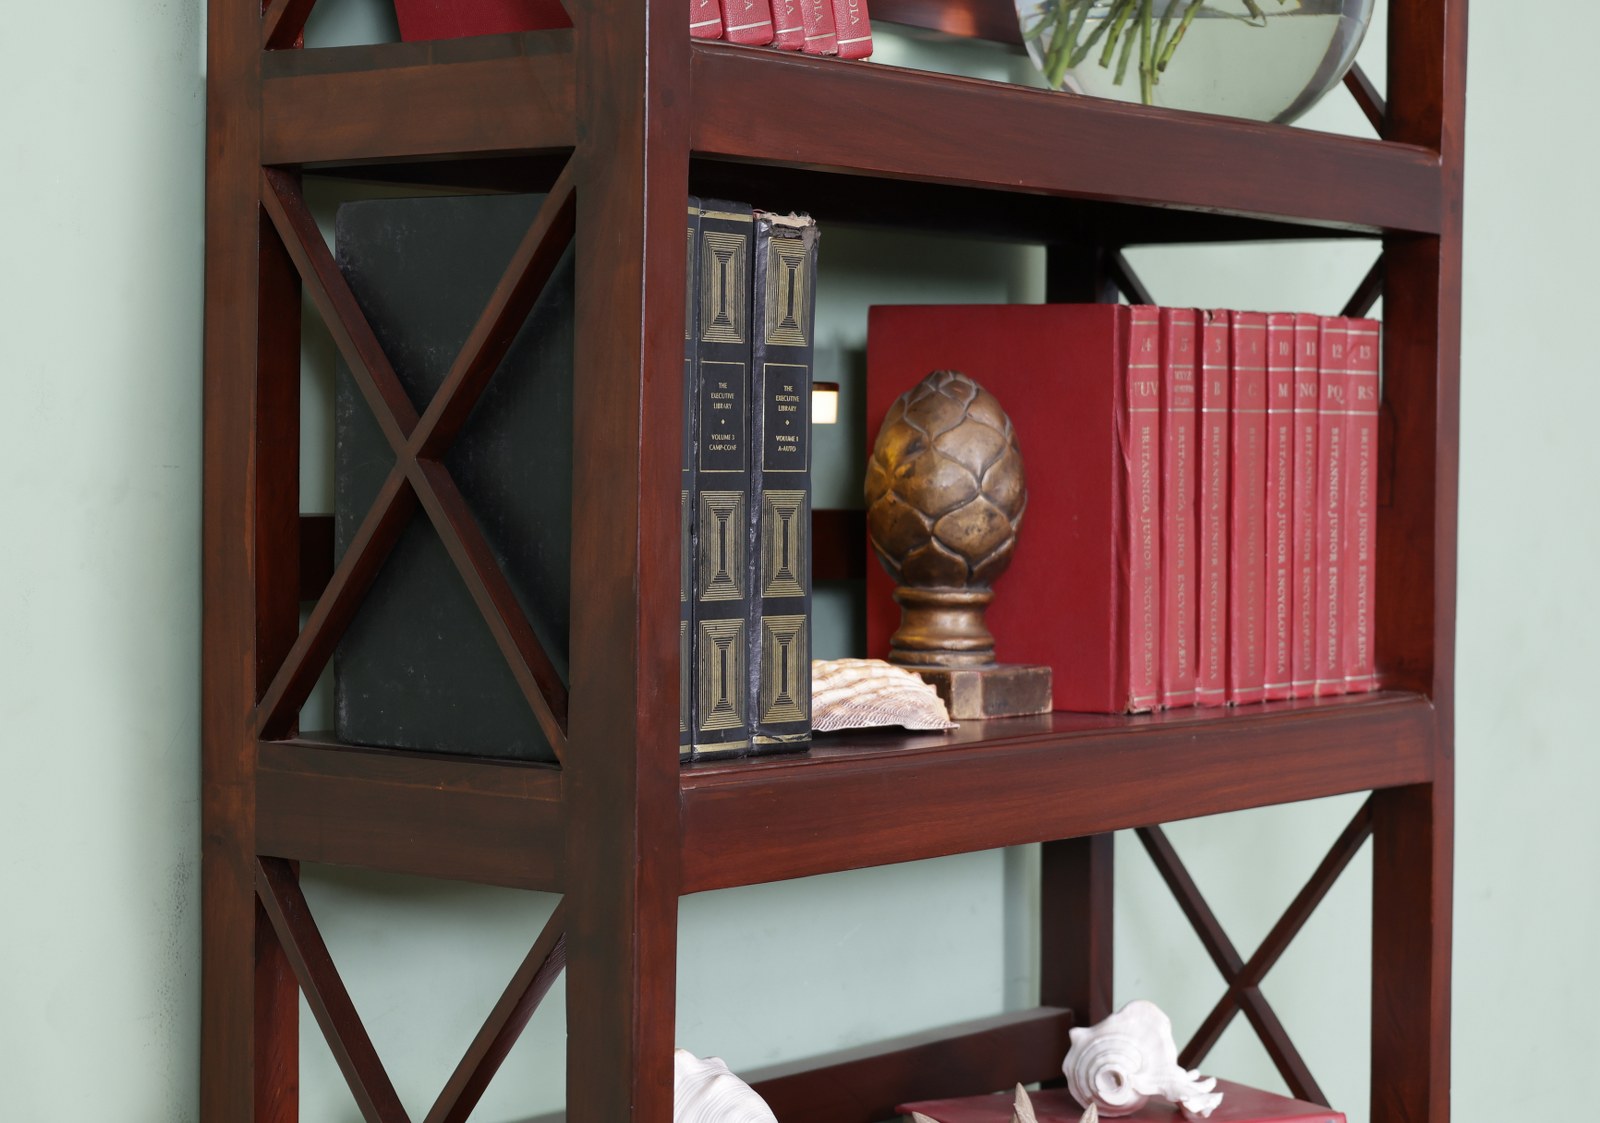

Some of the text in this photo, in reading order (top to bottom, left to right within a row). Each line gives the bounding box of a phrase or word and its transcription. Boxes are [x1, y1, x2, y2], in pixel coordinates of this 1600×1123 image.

[1279, 342, 1288, 355] 10
[1306, 342, 1316, 356] 11
[1332, 343, 1342, 358] 12
[1214, 381, 1220, 396] B
[1278, 383, 1288, 397] M
[1327, 384, 1344, 405] PQ
[1358, 385, 1374, 400] RS
[1142, 426, 1150, 513] BRITANNICA
[1177, 426, 1186, 511] BRITANNICA
[1212, 426, 1220, 510] BRITANNICA
[1279, 426, 1287, 509] BRITANNICA
[1330, 427, 1339, 508] BRITANNICA
[1360, 427, 1369, 508] BRITANNICA
[1141, 516, 1152, 569] JUNIOR
[1176, 515, 1185, 568] JUNIOR
[1211, 514, 1219, 566] JUNIOR
[1276, 512, 1286, 564] JUNIOR
[1328, 511, 1338, 562] JUNIOR
[1357, 511, 1369, 561] JUNIOR
